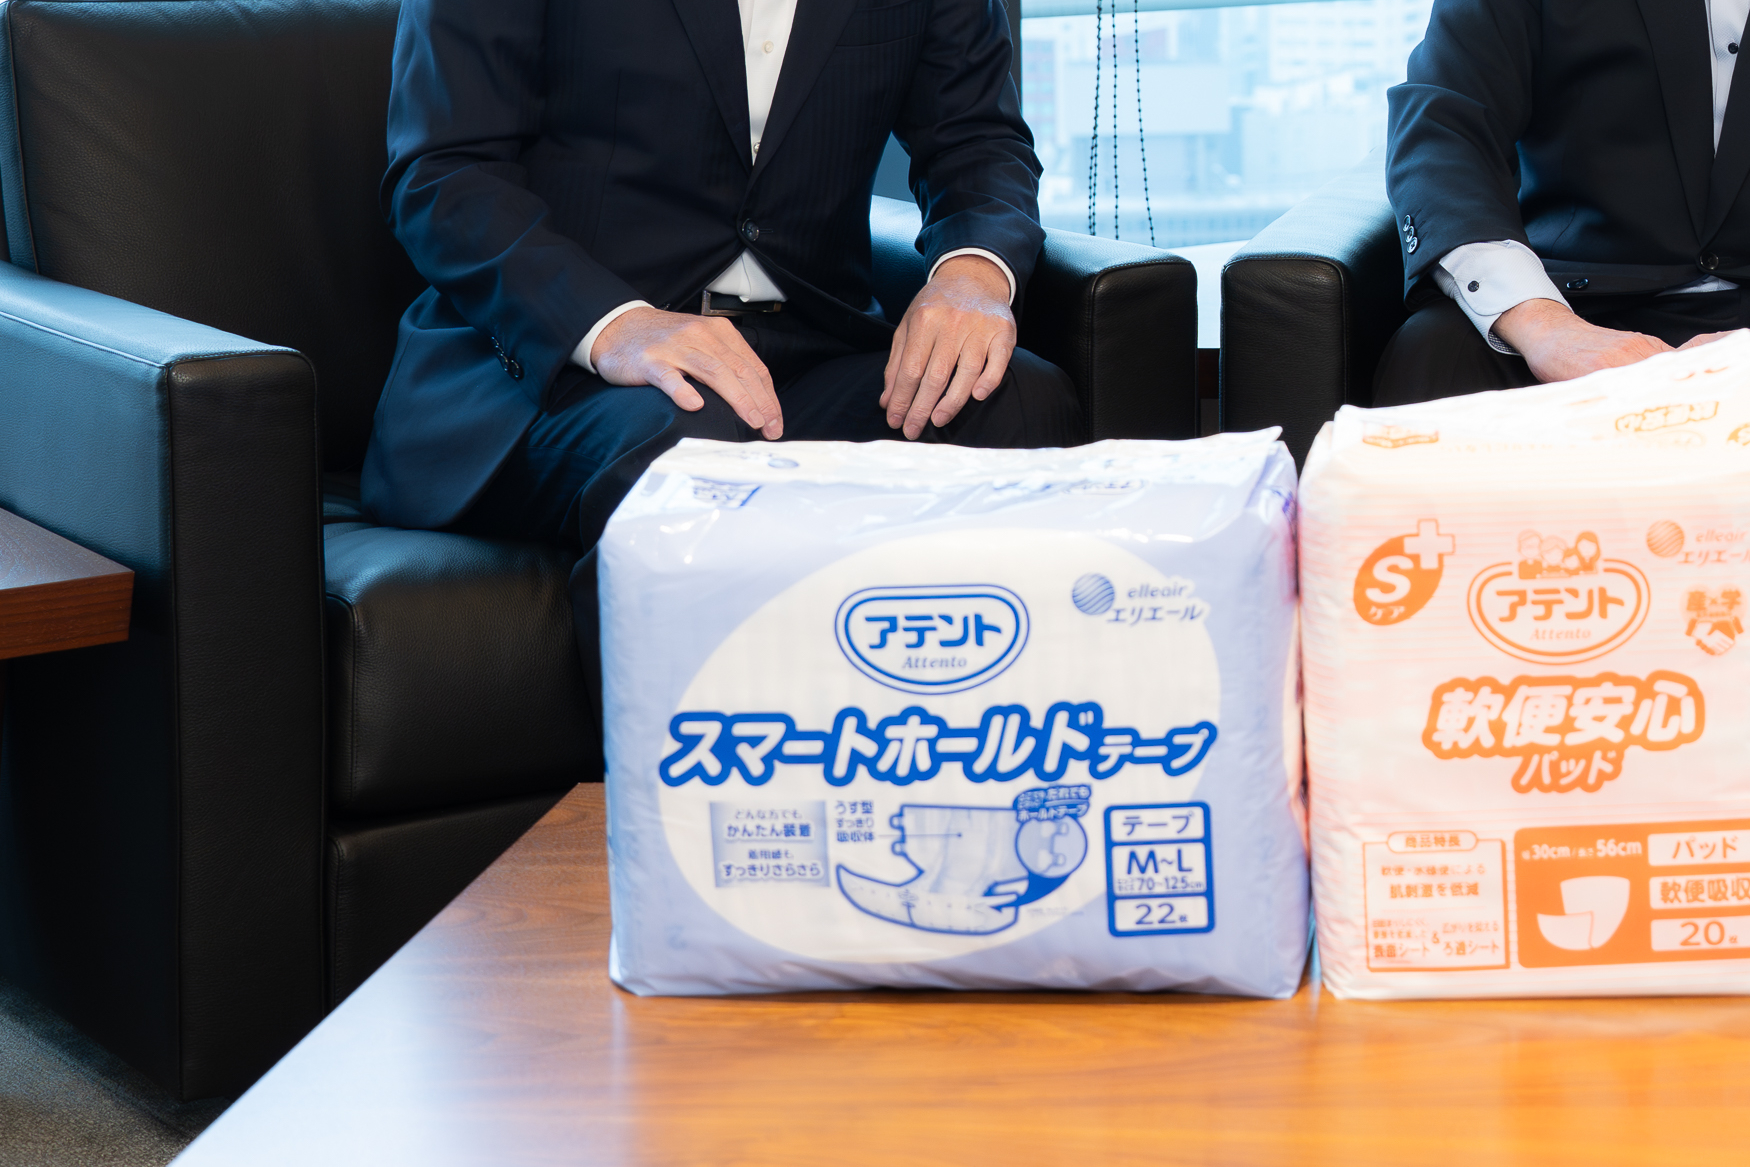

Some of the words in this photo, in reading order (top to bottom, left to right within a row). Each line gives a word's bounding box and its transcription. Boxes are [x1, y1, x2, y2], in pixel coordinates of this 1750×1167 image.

[1127, 583, 1188, 599] elleair
[1106, 604, 1205, 627] エリエール
[1495, 586, 1625, 622] アテント
[864, 613, 1002, 650] アテント
[1530, 626, 1592, 641] Attento
[901, 655, 967, 669] Attento
[1428, 675, 1700, 753] 軟便安心
[660, 702, 1216, 787] スマートホールドテープ
[1517, 749, 1620, 790] パッド
[835, 800, 874, 815] うす型
[1122, 810, 1195, 836] テープ
[1672, 835, 1739, 860] パッド
[723, 863, 821, 877] すっきりさらさら
